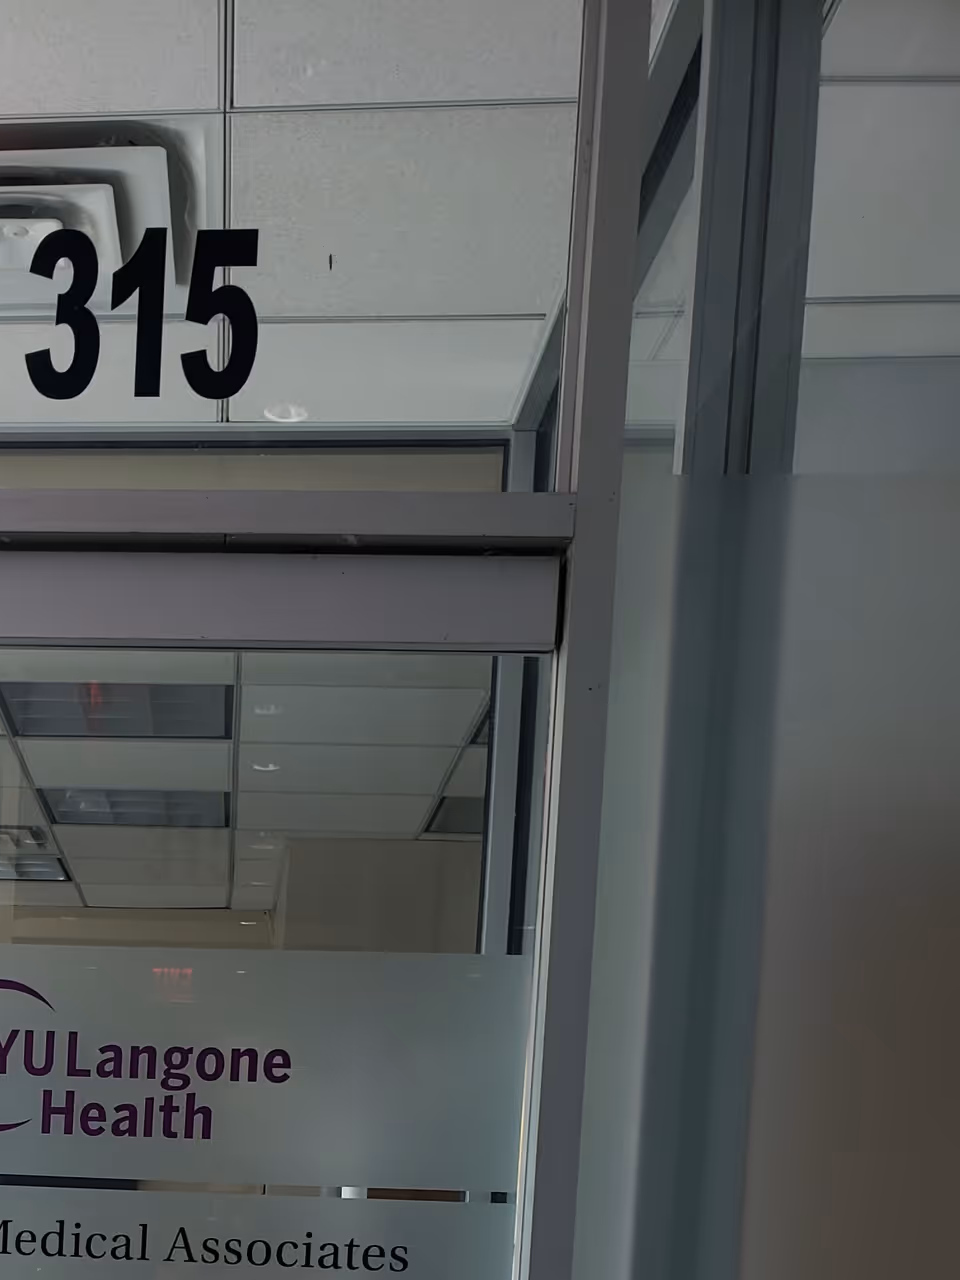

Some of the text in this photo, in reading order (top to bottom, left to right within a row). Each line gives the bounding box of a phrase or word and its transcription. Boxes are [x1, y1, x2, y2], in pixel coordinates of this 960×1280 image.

[25, 227, 259, 399] 315
[66, 1030, 292, 1091] Langone
[41, 1089, 213, 1140] Health
[162, 1226, 409, 1273] Associates
